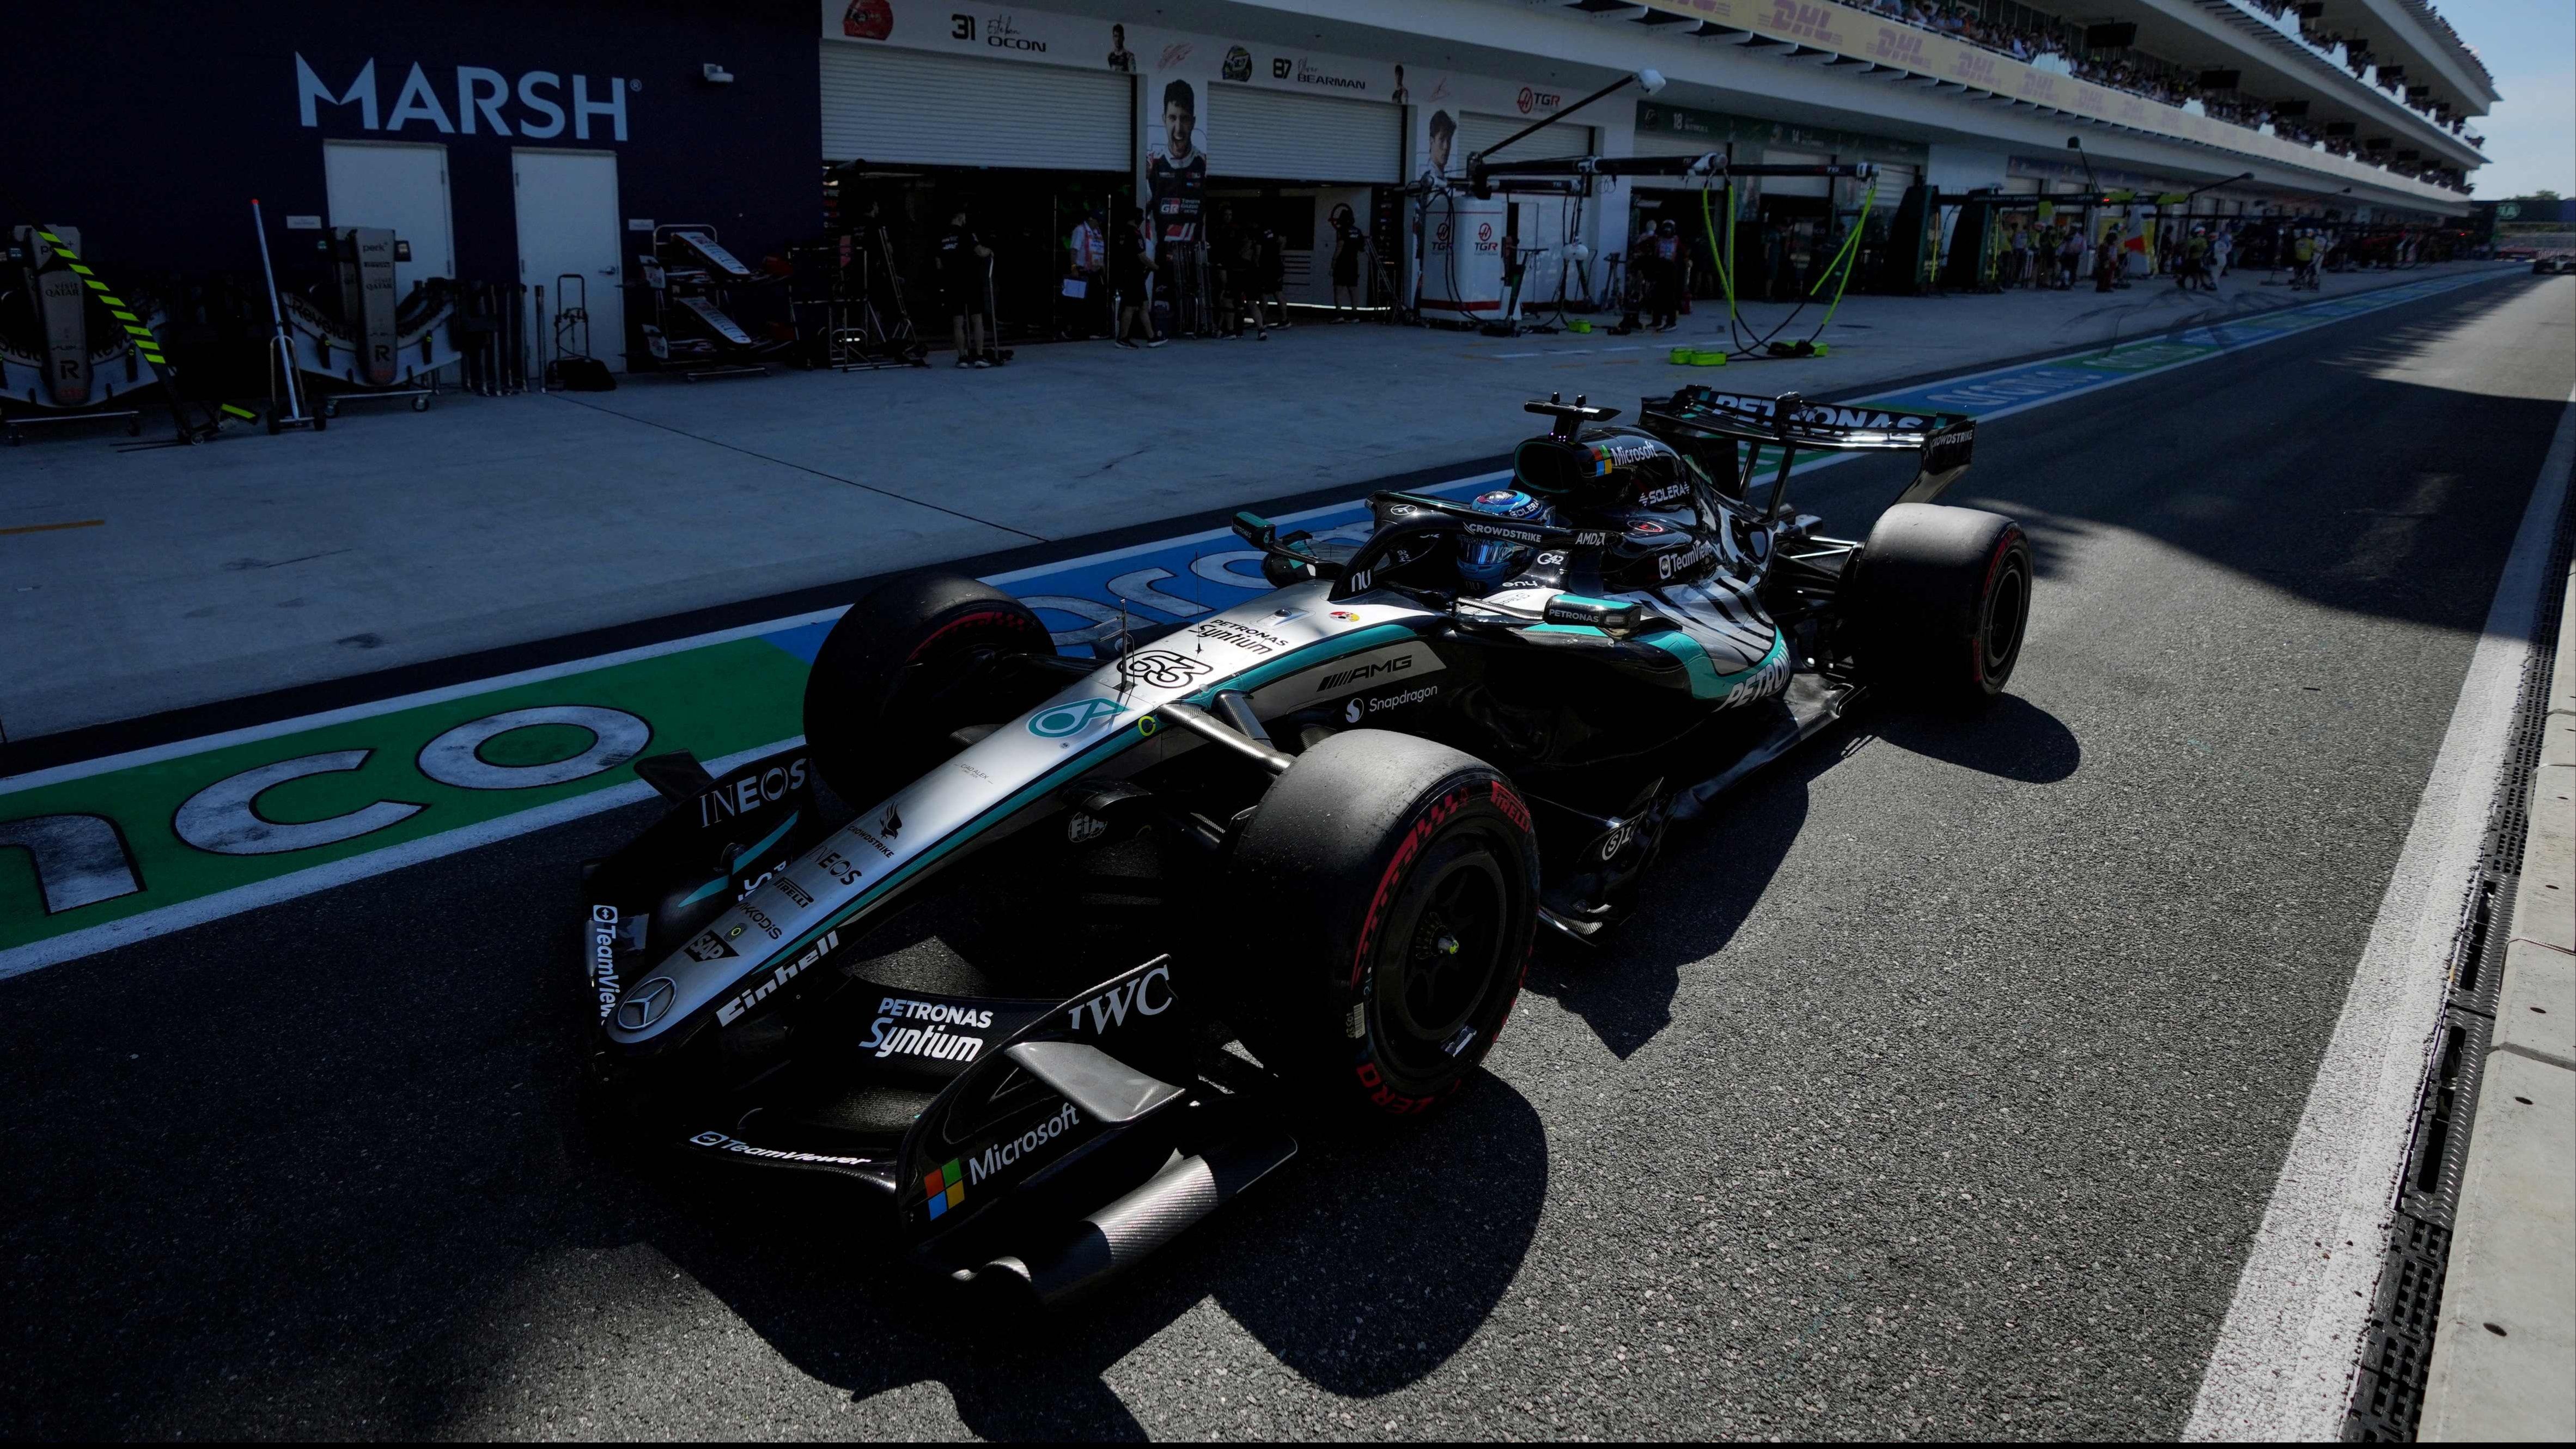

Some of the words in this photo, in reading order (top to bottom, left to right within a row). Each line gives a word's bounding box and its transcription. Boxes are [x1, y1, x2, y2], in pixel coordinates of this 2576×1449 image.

[951, 14, 976, 41] 31
[1770, 0, 1832, 41] DHL
[988, 36, 1046, 52] OCON
[1876, 26, 1925, 67] DHL
[1273, 58, 1292, 79] 87
[1298, 74, 1366, 89] BEARMAN
[1957, 51, 2001, 87] DHL
[1534, 93, 1561, 106] TGR
[1475, 242, 1498, 251] TGR
[46, 289, 80, 297] QATAR
[375, 345, 390, 362] R
[60, 360, 80, 379] R
[1712, 394, 1925, 436] PETONAS
[1611, 440, 1658, 466] Microsoft
[1509, 497, 1540, 518] SOLERA
[1648, 484, 1686, 504] SOLERA
[1469, 523, 1542, 544] CROWDSTRIKE
[1575, 532, 1598, 545] AMD
[1537, 552, 1564, 565] G42
[1351, 569, 1372, 593] nu
[1549, 608, 1599, 623] PETRONAS
[1187, 624, 1273, 655] Syntium
[1210, 619, 1289, 647] PETRONAS
[1116, 650, 1214, 689] 63
[1347, 655, 1412, 684] AMG
[1369, 685, 1438, 712] Snapdragon
[699, 758, 807, 829] INEOS
[1490, 780, 1531, 833] PIRELLI
[1071, 815, 1107, 839] FIA
[848, 825, 894, 859] CROWDSTRIKE
[806, 845, 862, 885] INEOS
[773, 876, 814, 909] PIRELLI
[689, 934, 725, 961] SAP
[596, 926, 621, 1026] TeamView
[715, 930, 839, 1027] Einhell
[878, 997, 994, 1028] PETRONAS
[1068, 964, 1173, 1035] IWC
[858, 1017, 984, 1062] Syntium
[720, 1139, 872, 1165] TeamViewer
[969, 1101, 1081, 1185] Microsoft
